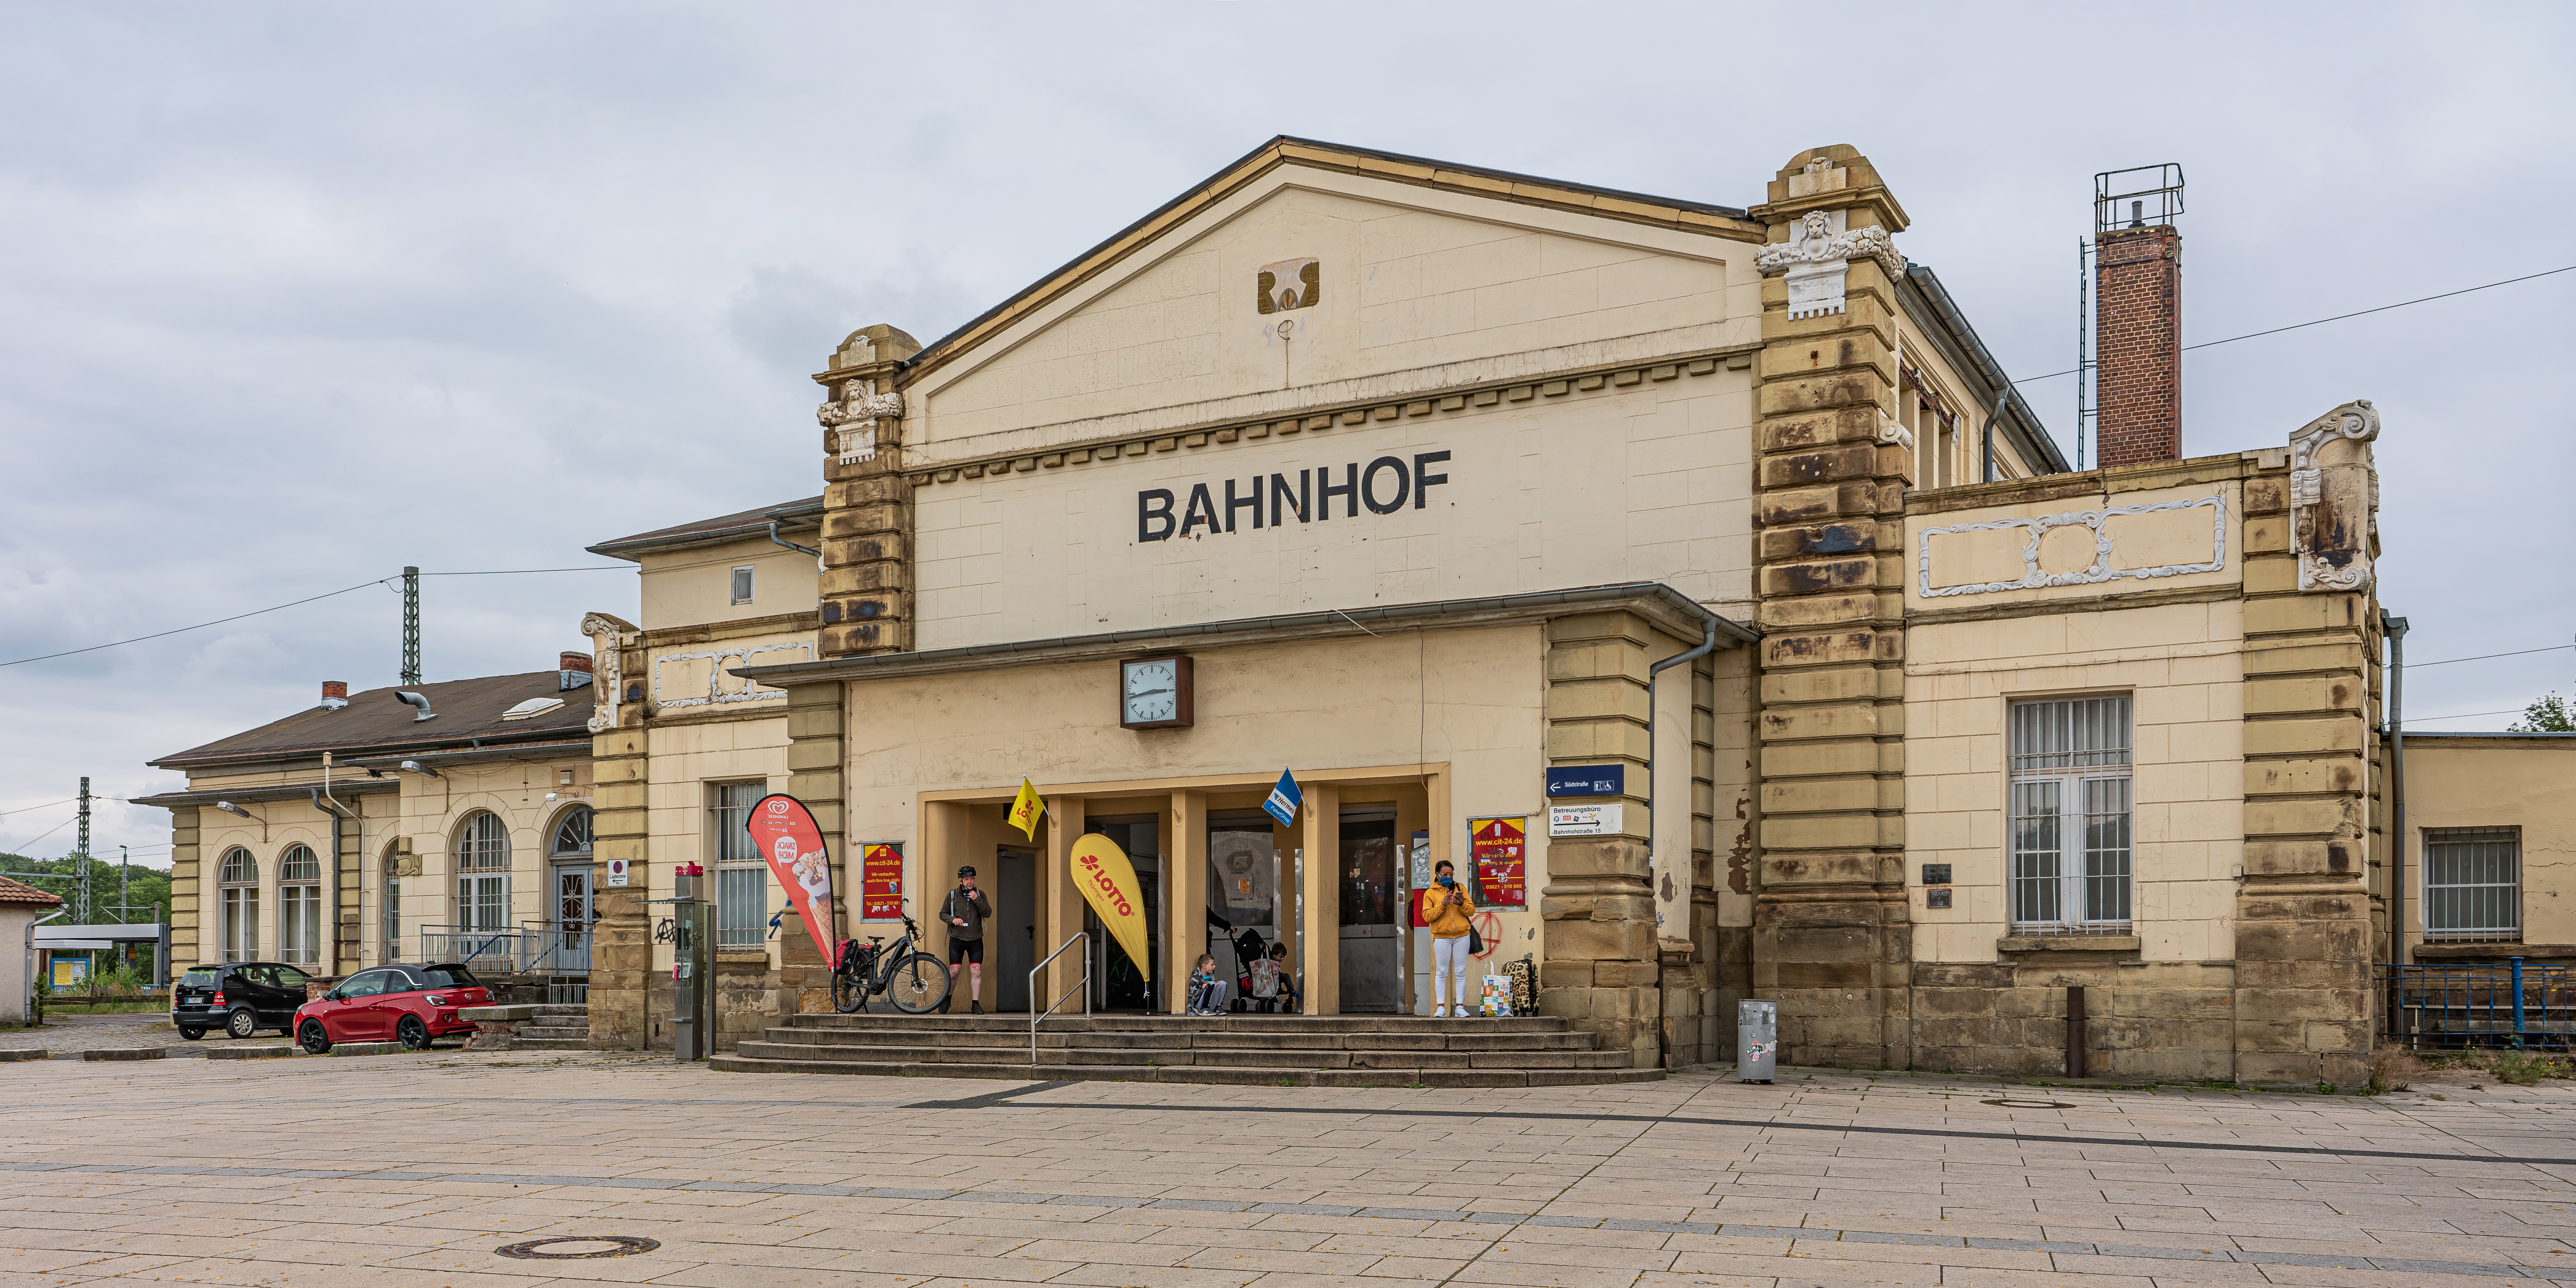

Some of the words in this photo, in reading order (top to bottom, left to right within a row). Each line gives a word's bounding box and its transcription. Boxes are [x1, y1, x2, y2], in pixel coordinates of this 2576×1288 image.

[1138, 450, 1451, 543] BAHNHOF
[1270, 805, 1290, 823] PaketShop
[1277, 797, 1295, 814] Hermes
[1087, 879, 1104, 902] Thüringen
